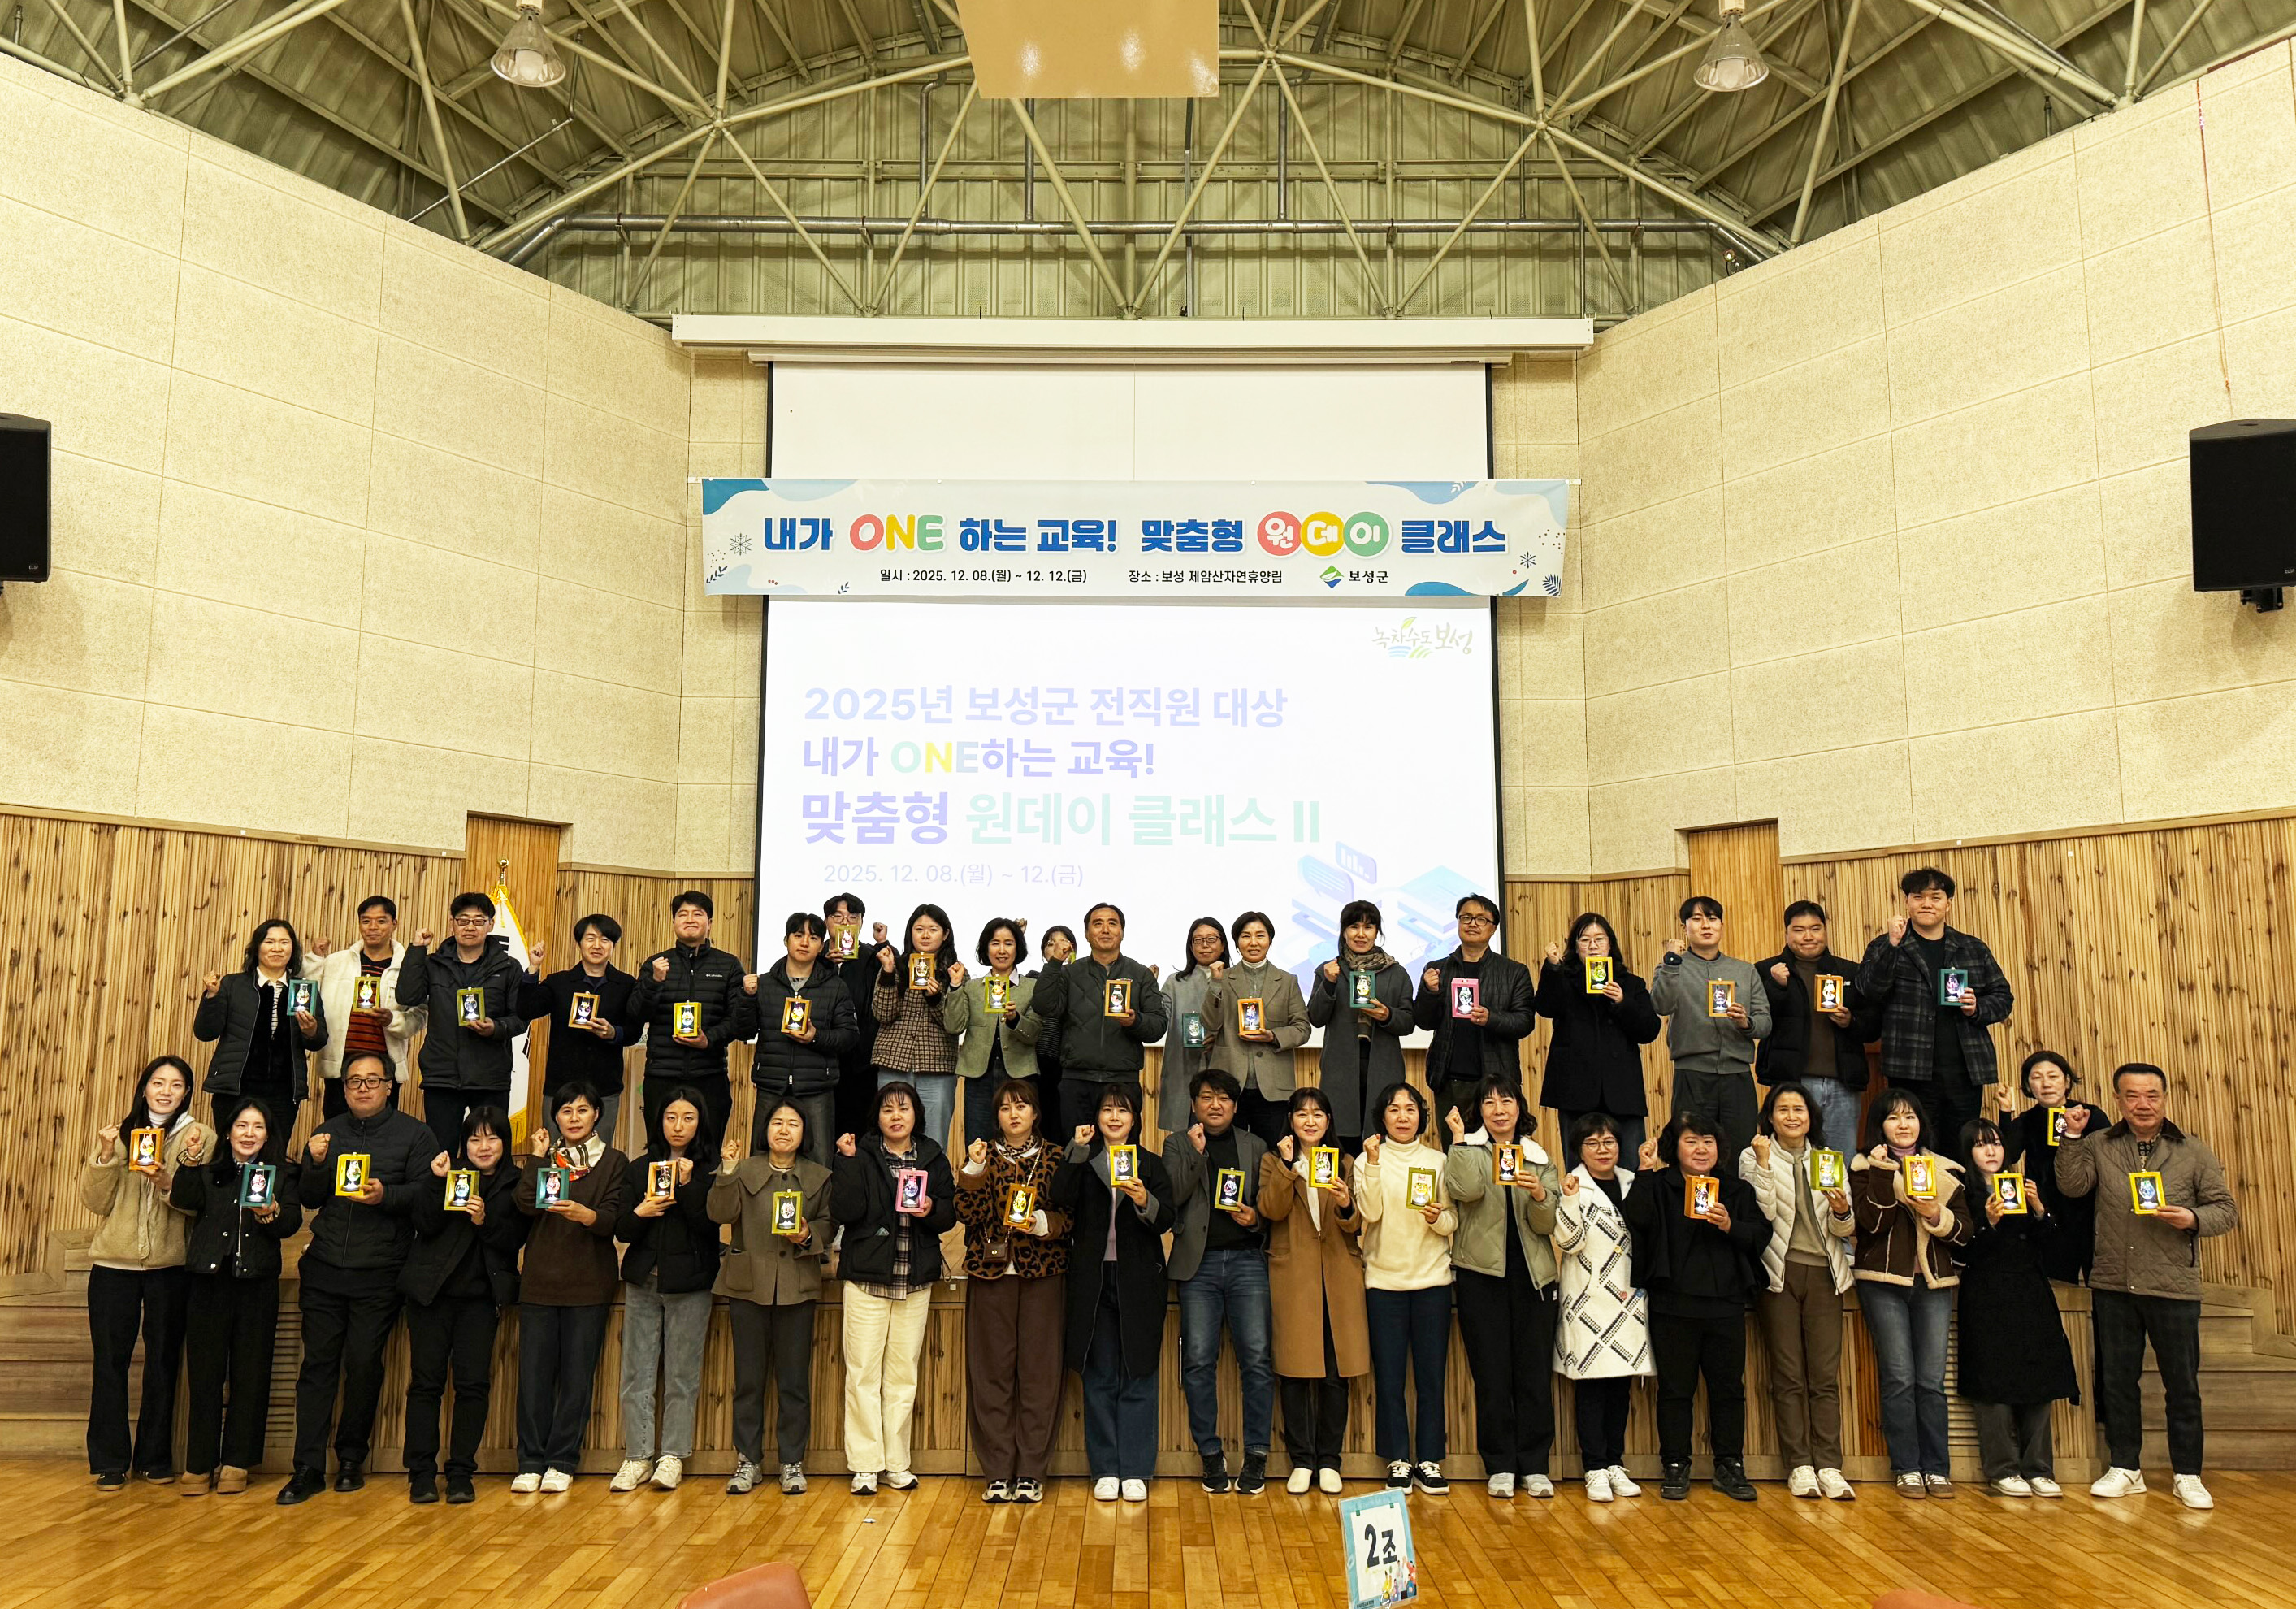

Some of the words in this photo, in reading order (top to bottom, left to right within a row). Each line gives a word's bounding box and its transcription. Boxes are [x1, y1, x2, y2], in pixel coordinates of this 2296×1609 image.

[765, 518, 833, 551] 내가
[849, 514, 942, 552] ONE
[960, 518, 1026, 552] 하는
[1037, 519, 1116, 553] 교육!
[1142, 519, 1243, 553] 맞춤형
[1264, 517, 1380, 549] 원데이
[1402, 521, 1505, 553] 클래스
[880, 569, 903, 582] 일시
[912, 570, 947, 582] 2025.
[951, 570, 968, 582] 12.
[972, 569, 1012, 583] 08.(월)
[1026, 570, 1045, 582] 12.
[1049, 570, 1087, 583] 12.(금)
[1129, 570, 1152, 583] 장소
[1161, 570, 1185, 583] 보성
[1189, 570, 1282, 583] 제암산자연휴양림
[1349, 570, 1389, 583] 보성군
[1434, 622, 1473, 655] 보성
[804, 684, 953, 724] 2025년
[965, 686, 1079, 726] 보성군
[1090, 687, 1201, 727] 전직원
[1213, 688, 1289, 728] 대상
[803, 735, 880, 778] 내가
[1066, 739, 1154, 779] 교육!
[802, 791, 948, 845] 맞춤형
[966, 792, 1111, 846] 원데이
[1129, 794, 1277, 848] 클래스
[825, 865, 885, 883] 2025.
[892, 865, 919, 883] 12.
[926, 865, 993, 887] 08.(월)
[1020, 865, 1084, 887] 12.(금)
[1364, 1524, 1397, 1568] 2조
